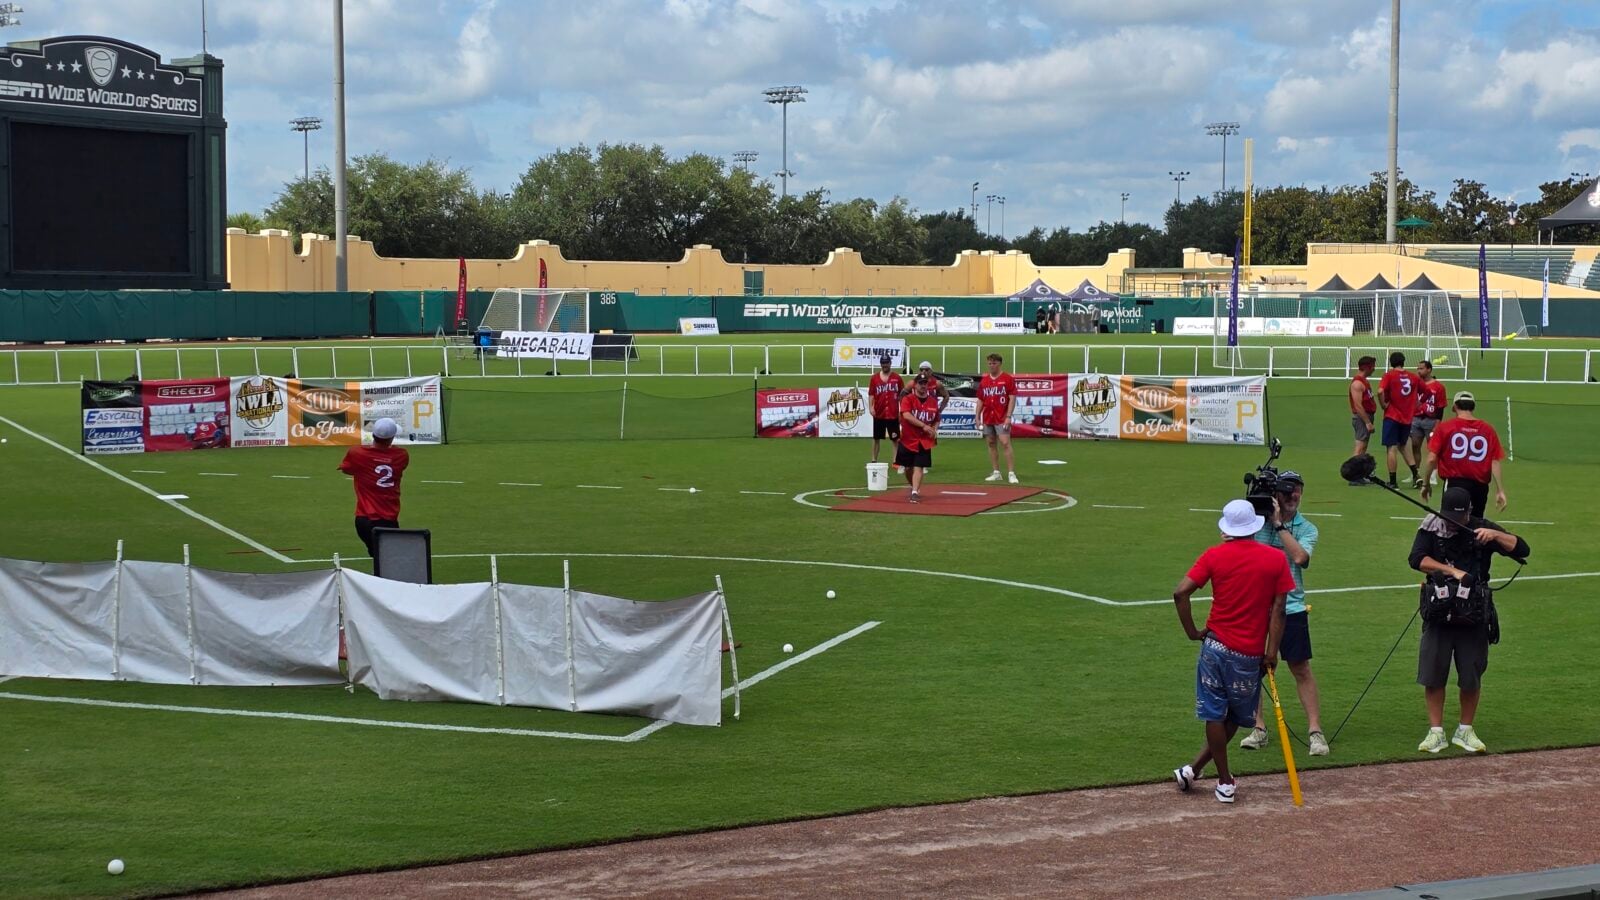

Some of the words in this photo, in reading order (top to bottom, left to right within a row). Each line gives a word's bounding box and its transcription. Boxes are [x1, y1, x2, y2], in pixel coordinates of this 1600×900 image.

[0, 79, 44, 98] ESPN
[47, 84, 85, 102] WIDE
[87, 87, 135, 107] WORLD
[136, 96, 150, 108] OF
[150, 94, 198, 112] SPORTS
[600, 293, 616, 305] 385
[1226, 299, 1244, 309] 35
[744, 303, 790, 317] ESPN
[791, 303, 829, 317] WIDE
[831, 304, 879, 317] WORLD
[880, 306, 895, 318] OF
[895, 304, 945, 317] SPORTS
[1114, 307, 1143, 318] World
[857, 347, 900, 357] SUNBELT
[162, 386, 212, 396] SHEETZ
[876, 383, 899, 395] NWLA
[1017, 381, 1049, 389] EETZ
[1191, 385, 1226, 393] WASHINGTON
[1226, 385, 1247, 393] COUNTY
[1399, 377, 1412, 396] 3
[237, 391, 282, 412] NWLA
[305, 392, 341, 411] SCOTT
[770, 394, 806, 402] SHEETZ
[1074, 389, 1115, 408] NWLA
[1137, 389, 1169, 409] SCOTT
[413, 400, 434, 429] P
[828, 399, 865, 415] NWLA
[1236, 400, 1258, 429] P
[86, 410, 137, 425] EASYCALL
[291, 422, 316, 438] Go
[316, 420, 358, 441] Yard
[1122, 420, 1145, 434] Go
[1145, 418, 1184, 437] Yard
[1450, 432, 1488, 462] 99
[374, 464, 395, 488] 2
